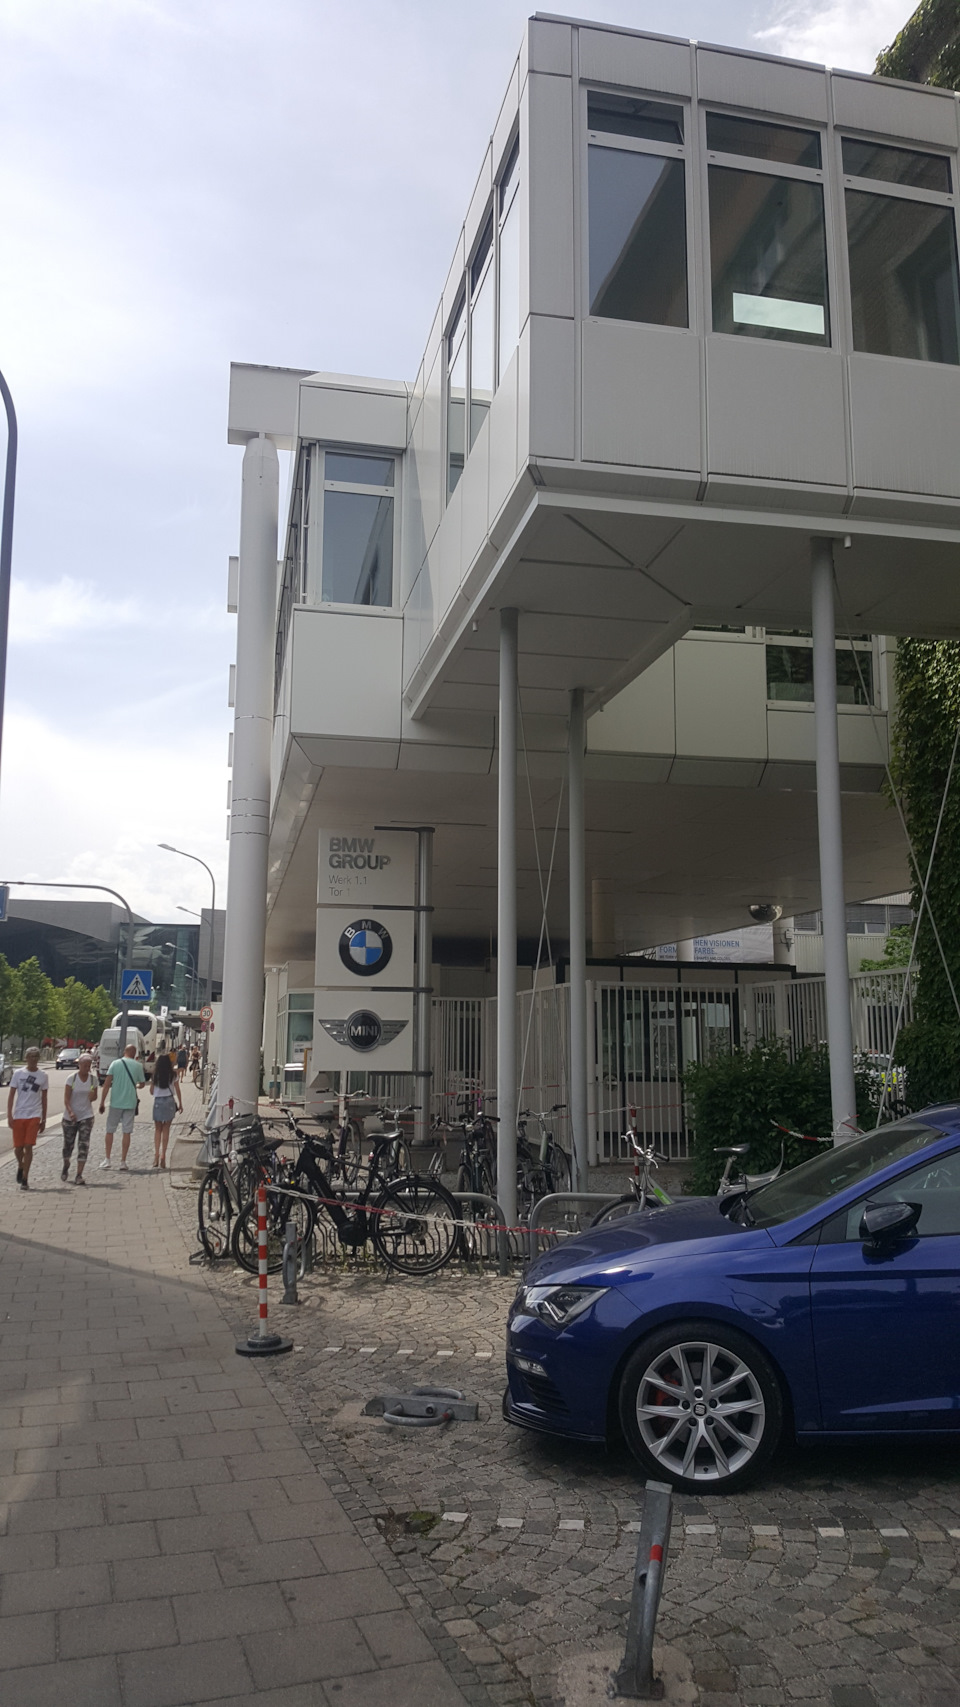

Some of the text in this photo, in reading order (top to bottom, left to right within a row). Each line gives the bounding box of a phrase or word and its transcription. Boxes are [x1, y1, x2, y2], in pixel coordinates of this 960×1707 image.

[329, 837, 375, 853] BMW
[328, 853, 391, 870] GROUP
[328, 874, 367, 885] Werk 1.1
[328, 886, 343, 897] Tor
[344, 920, 389, 939] BMW
[709, 940, 740, 948] VISIONEN
[350, 1025, 378, 1036] MINI
